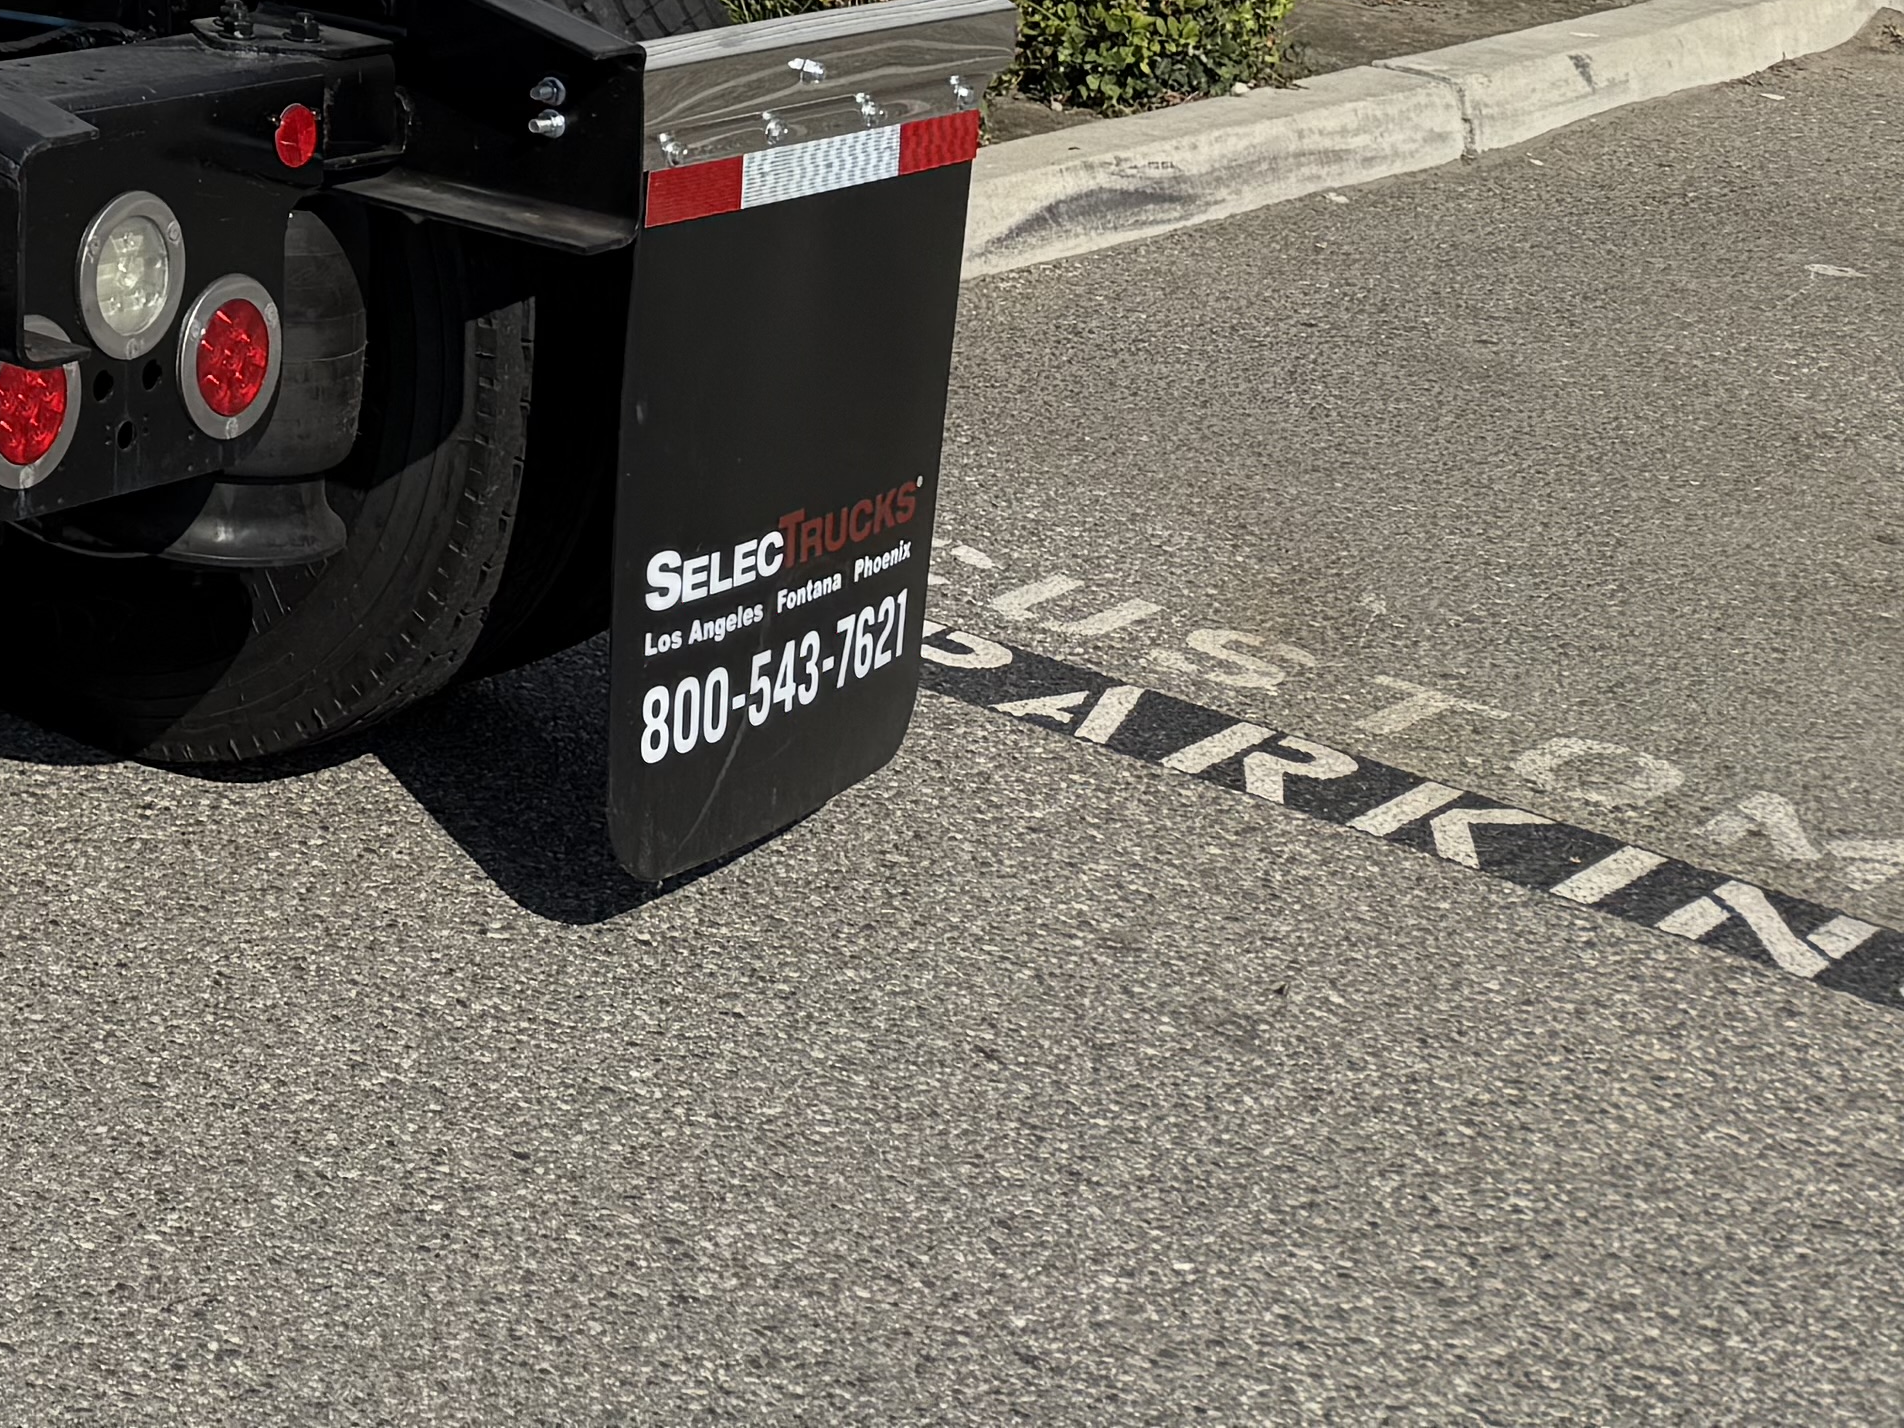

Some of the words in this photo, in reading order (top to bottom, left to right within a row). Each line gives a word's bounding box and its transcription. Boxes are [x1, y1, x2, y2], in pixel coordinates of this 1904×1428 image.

[640, 588, 908, 764] 800-543-7621
[644, 628, 682, 656] Los
[688, 603, 764, 644] Angeles
[776, 571, 842, 614] Fontana
[853, 540, 911, 583] Phoenix
[920, 620, 1904, 1000] PARKIN
